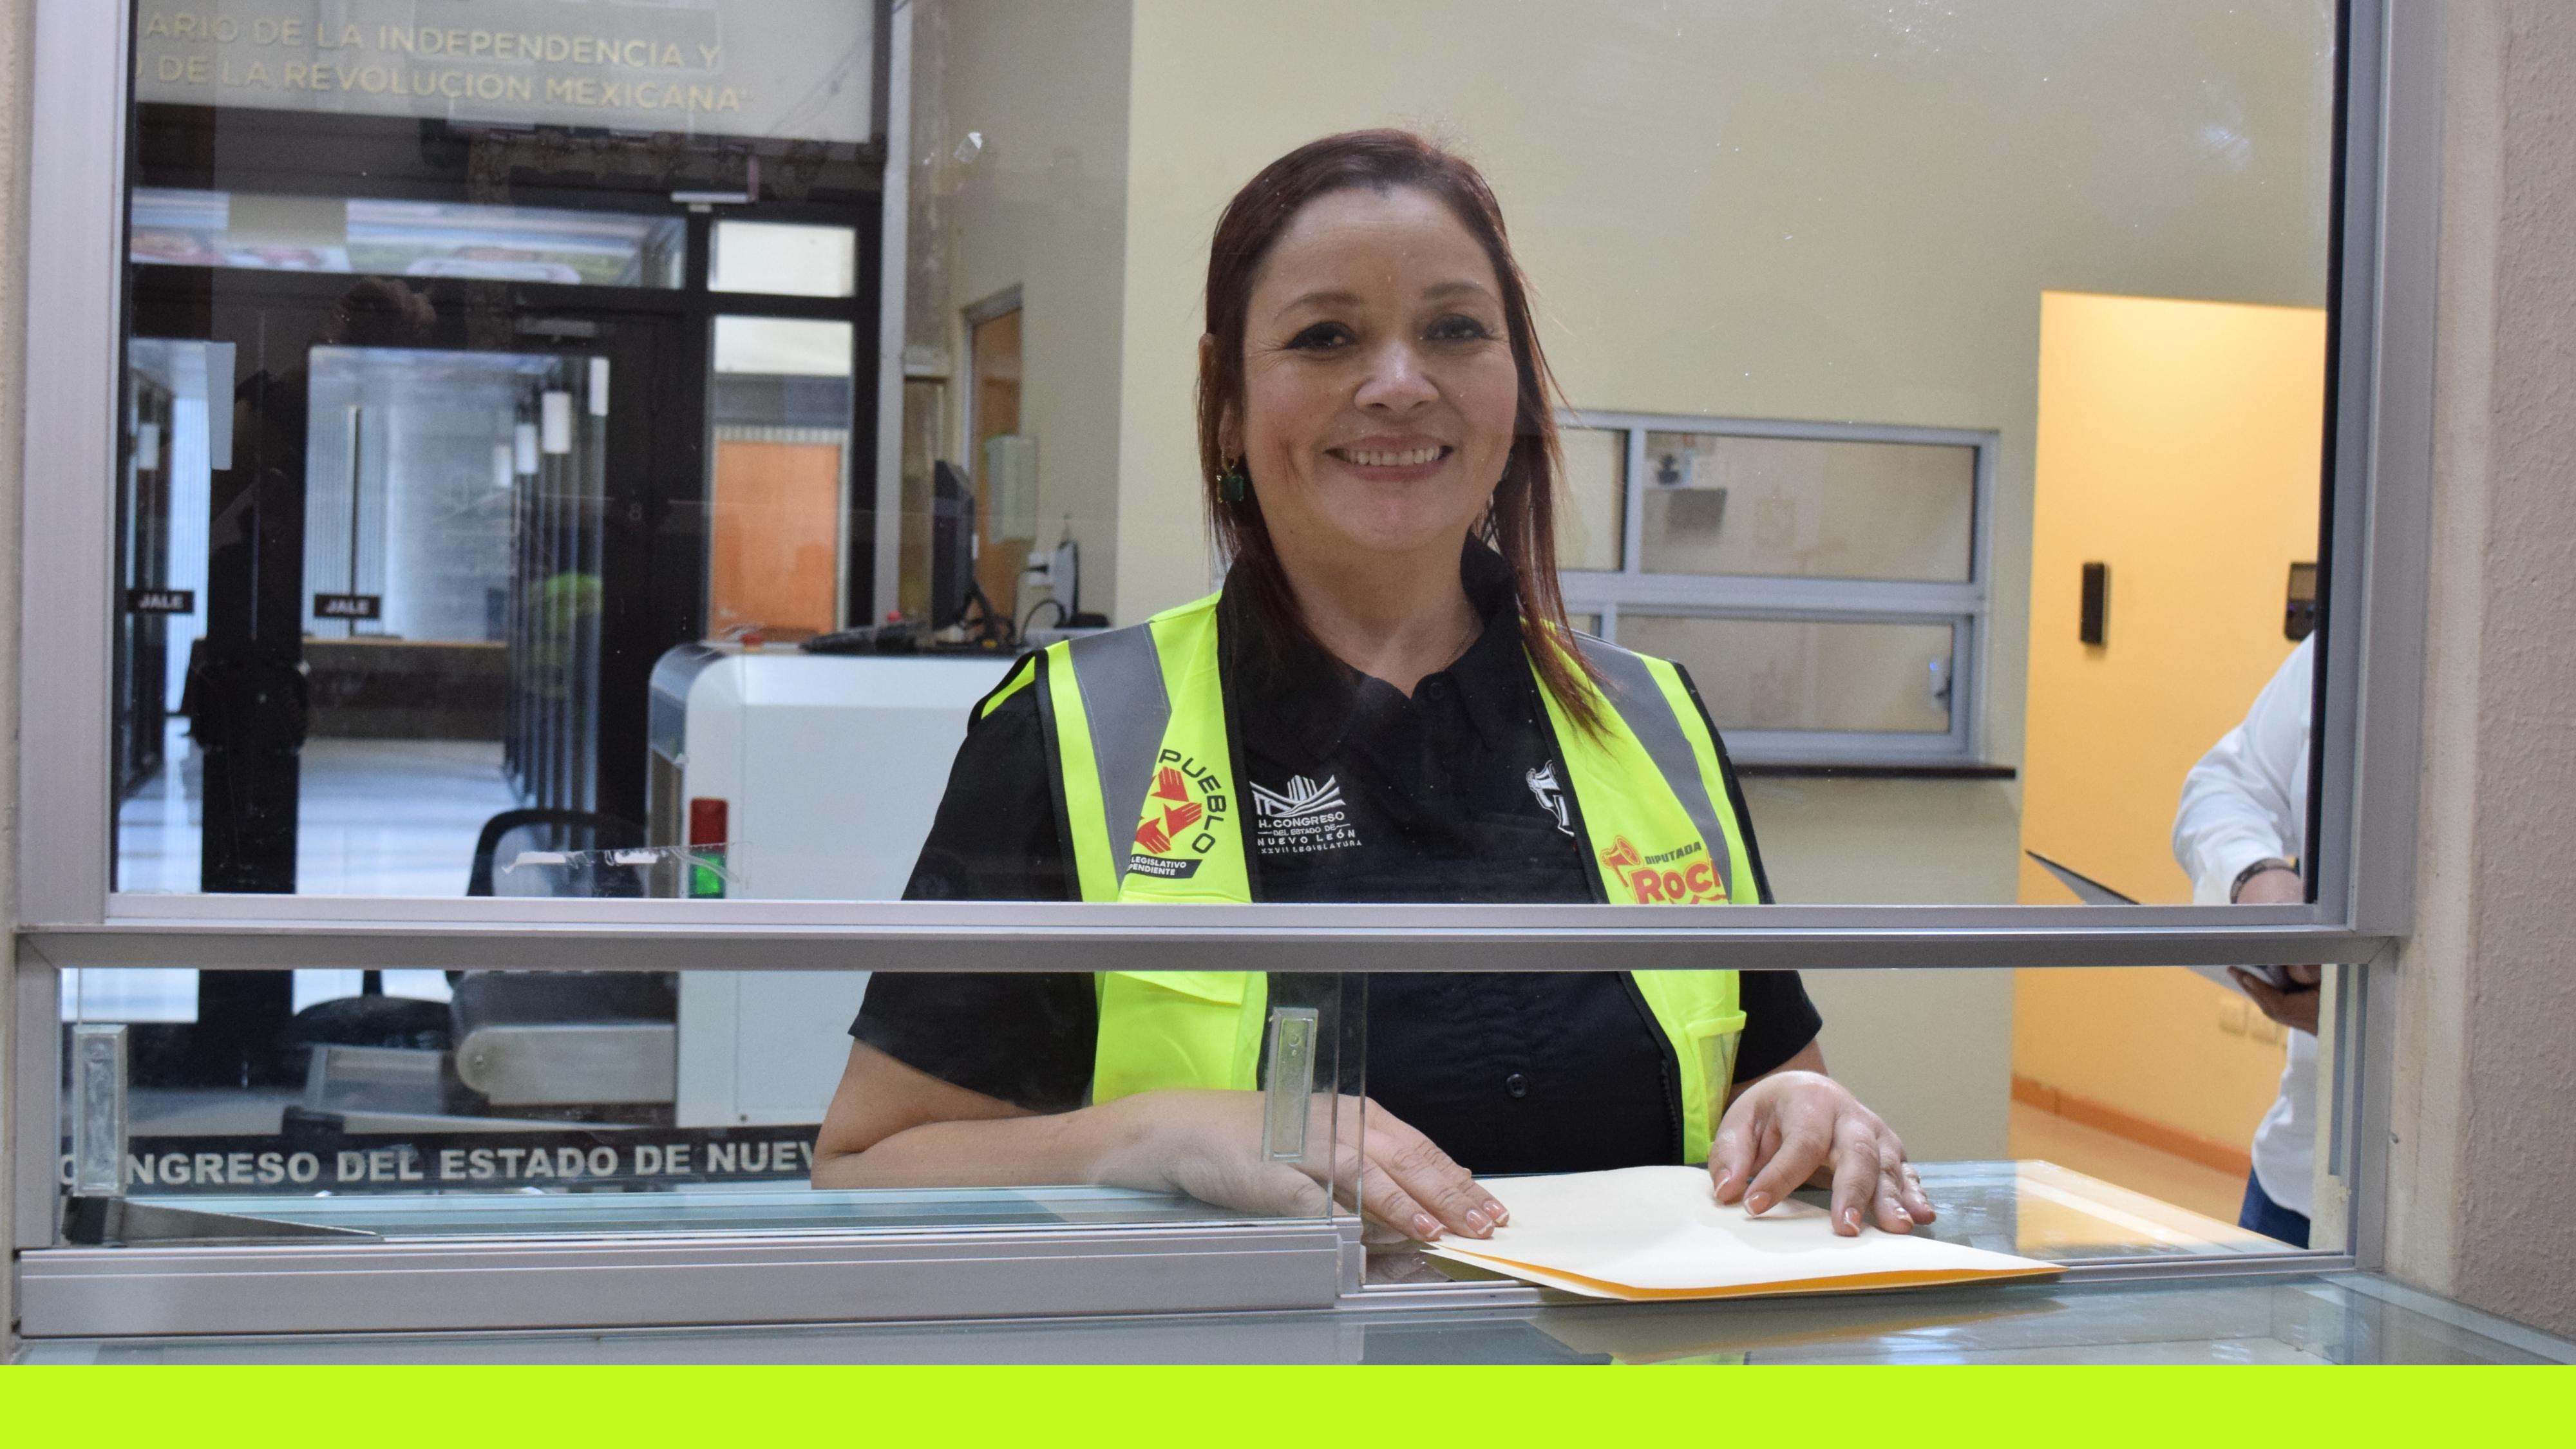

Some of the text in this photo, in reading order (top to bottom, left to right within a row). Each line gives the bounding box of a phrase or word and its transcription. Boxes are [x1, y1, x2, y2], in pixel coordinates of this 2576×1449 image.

[254, 19, 303, 47] DE
[317, 24, 363, 50] LA
[377, 25, 685, 68] INDEPENDENCIA
[697, 43, 721, 70] Y
[158, 55, 207, 84] DE
[222, 61, 269, 88] LA
[138, 594, 184, 610] JALE
[325, 598, 370, 615] JALE
[1159, 749, 1226, 854] PUEBLO
[1273, 811, 1345, 828] CONGRESO
[1257, 829, 1356, 846] NUEVO LEÓN
[1293, 839, 1363, 853] LEGISLATURA
[1644, 841, 1702, 865] DIPUTADA
[1131, 856, 1187, 869] LEGISLATIVO
[336, 1150, 424, 1182] DEL
[439, 1146, 619, 1180] ESTADO
[634, 1144, 691, 1176] DE
